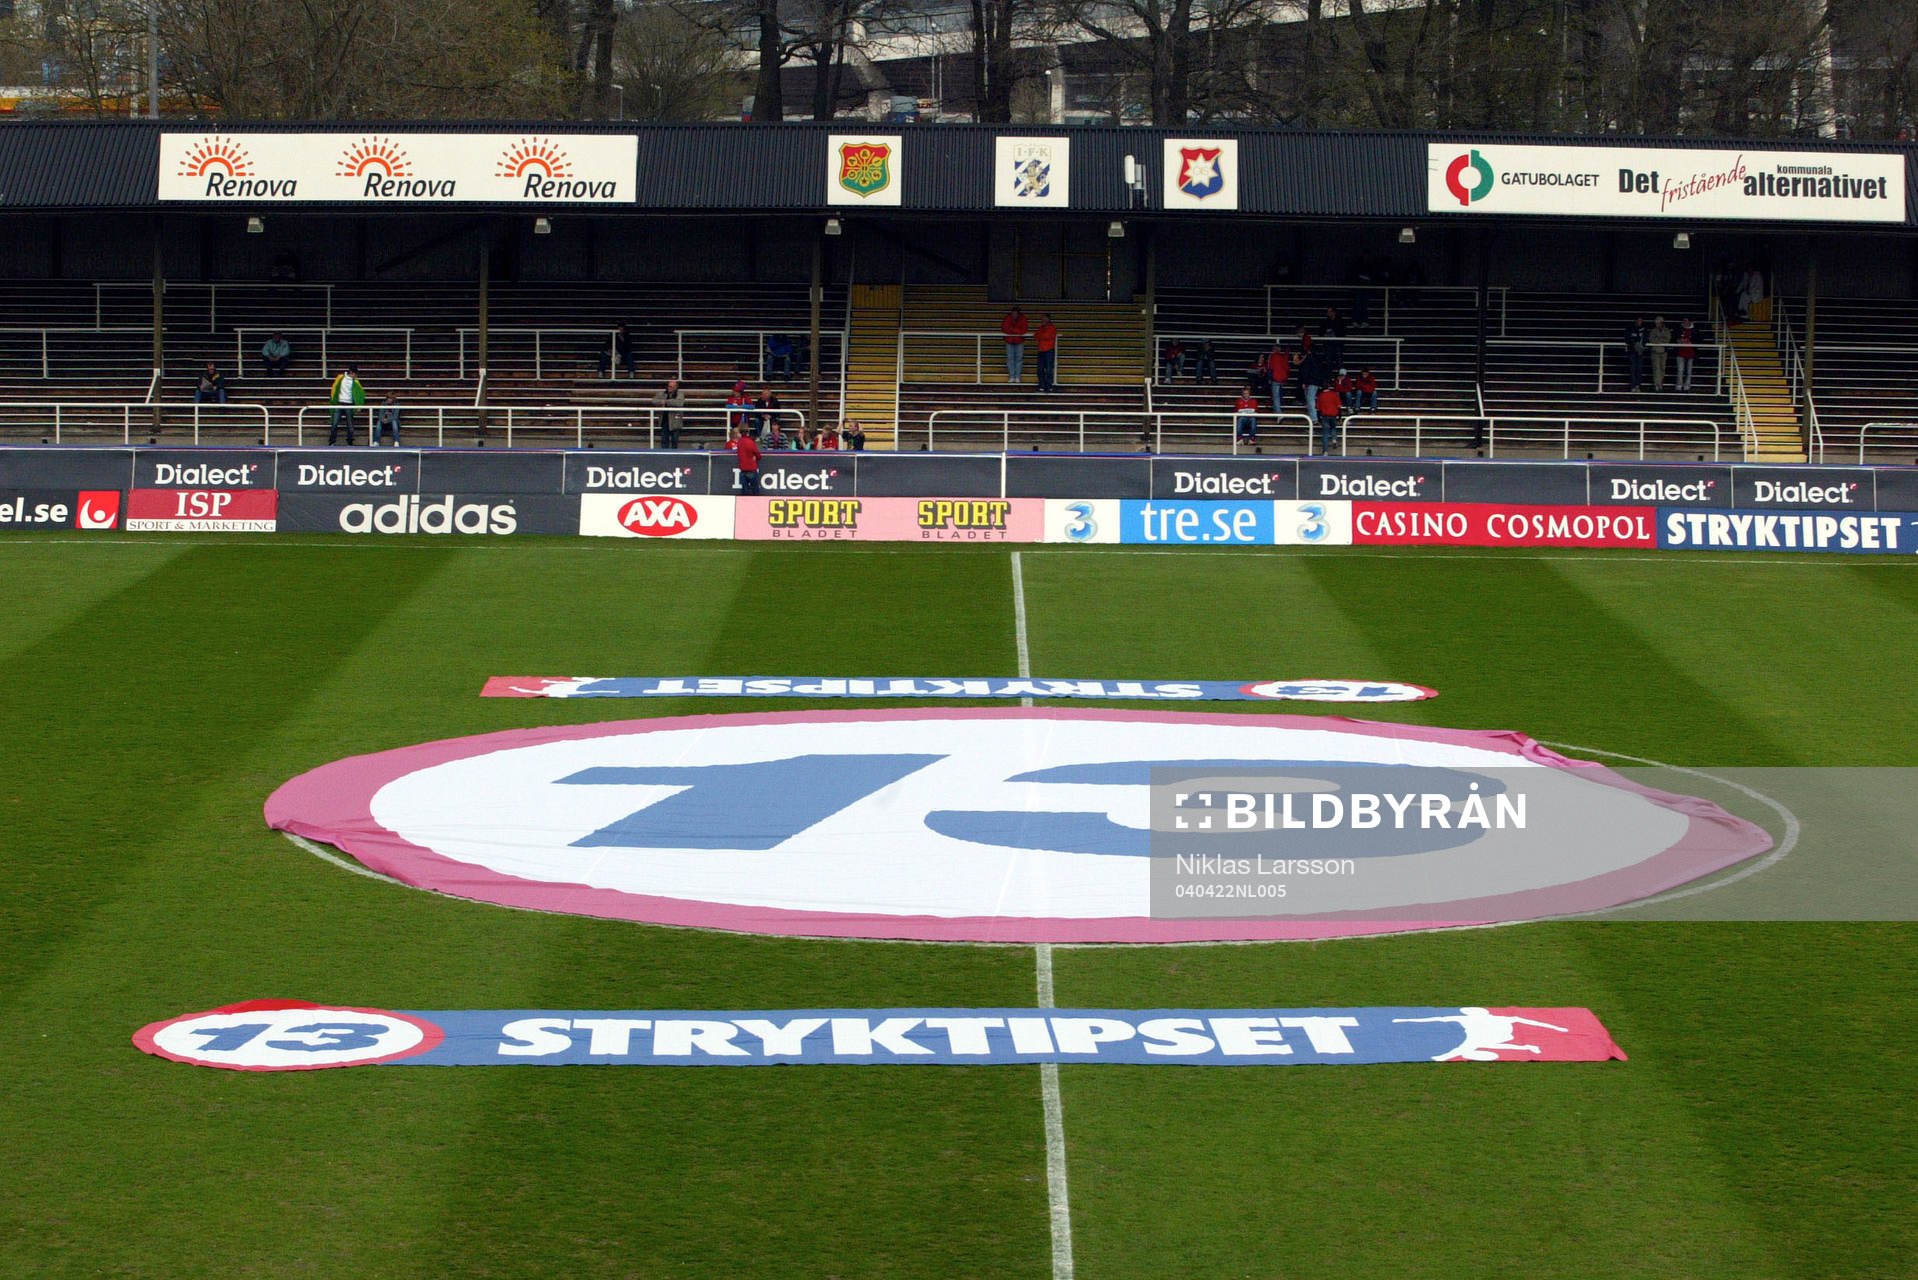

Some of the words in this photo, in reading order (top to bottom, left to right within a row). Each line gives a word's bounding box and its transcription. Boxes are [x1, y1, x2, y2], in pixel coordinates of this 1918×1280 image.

[1501, 171, 1599, 187] GATUBOLAGET
[1777, 164, 1833, 175] kommunala
[205, 172, 297, 198] Renova
[363, 172, 456, 199] Renova
[523, 173, 617, 199] Renova
[1618, 168, 1660, 194] Det
[1661, 154, 1747, 212] fristående
[1743, 172, 1888, 200] alternativet
[155, 463, 250, 486] Dialect
[297, 464, 394, 487] Dialect
[586, 466, 682, 489] Dialect
[1174, 471, 1272, 494] Dialect
[1319, 473, 1418, 497] Dialect
[1610, 478, 1708, 501] Dialect
[1754, 481, 1852, 504] Dialect
[175, 492, 232, 517] ISP
[339, 494, 517, 535] adidas
[624, 500, 691, 528] AXA
[768, 499, 862, 529] SPORT
[917, 499, 1011, 530] SPORT
[129, 521, 170, 530] SPORT
[174, 521, 184, 530] &
[188, 521, 275, 531] MARKETING
[772, 529, 858, 539] BLADET
[922, 530, 1008, 540] BLADET
[1140, 502, 1257, 542] tre.se
[1356, 511, 1468, 538] CASINO
[1486, 513, 1650, 540] COSMOPOL
[1667, 512, 1902, 549] STRYKTIPSET
[552, 753, 1508, 857] 13
[191, 1022, 390, 1051] 13
[497, 1016, 1360, 1058] STRYKTIPSET
